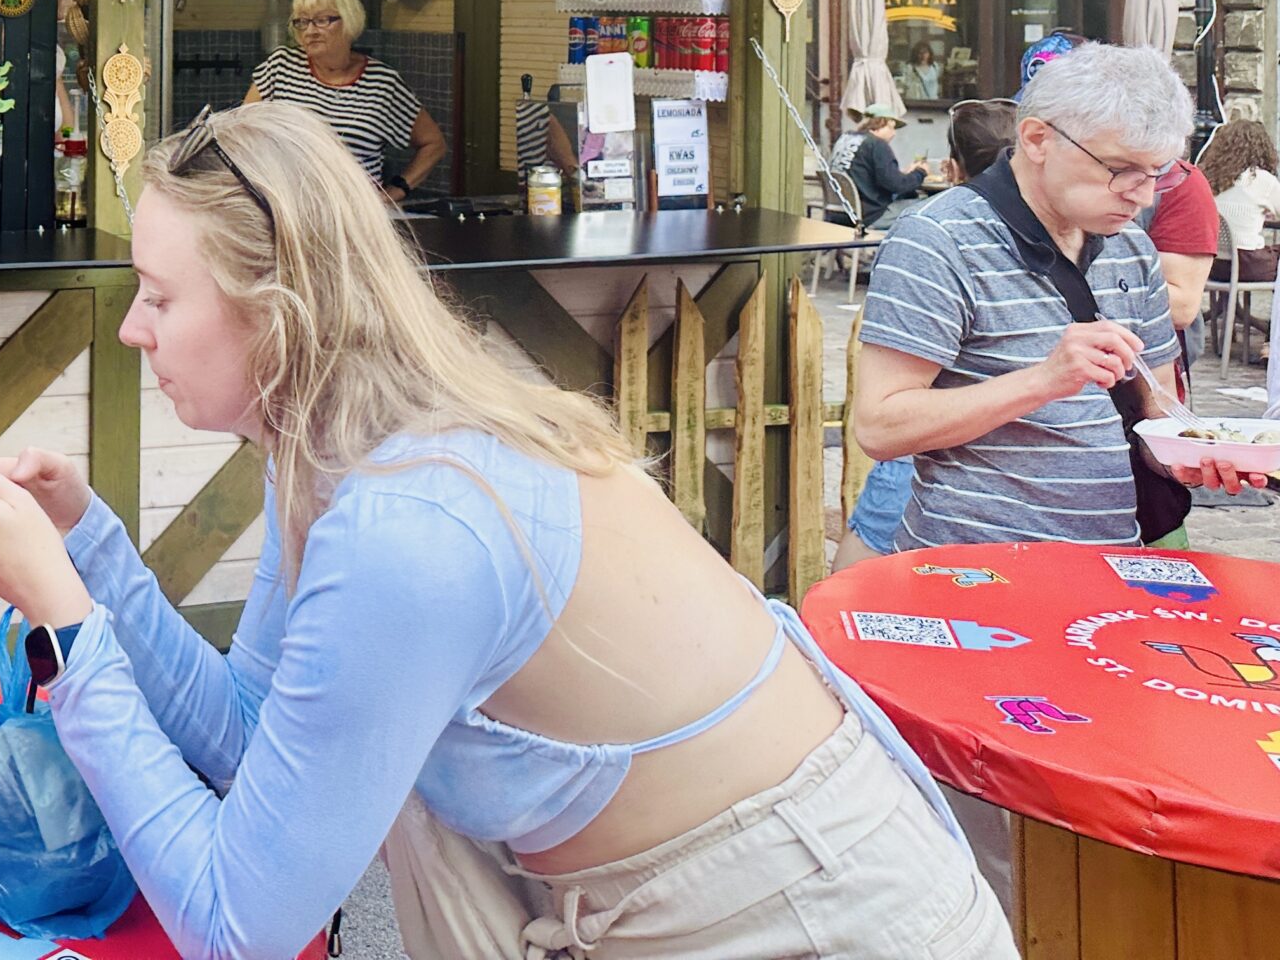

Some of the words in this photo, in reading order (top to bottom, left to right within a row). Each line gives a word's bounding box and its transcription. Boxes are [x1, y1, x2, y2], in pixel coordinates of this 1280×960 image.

[668, 149, 696, 161] KWAS
[1064, 609, 1150, 651] JARMARK
[1086, 656, 1135, 678] ST.
